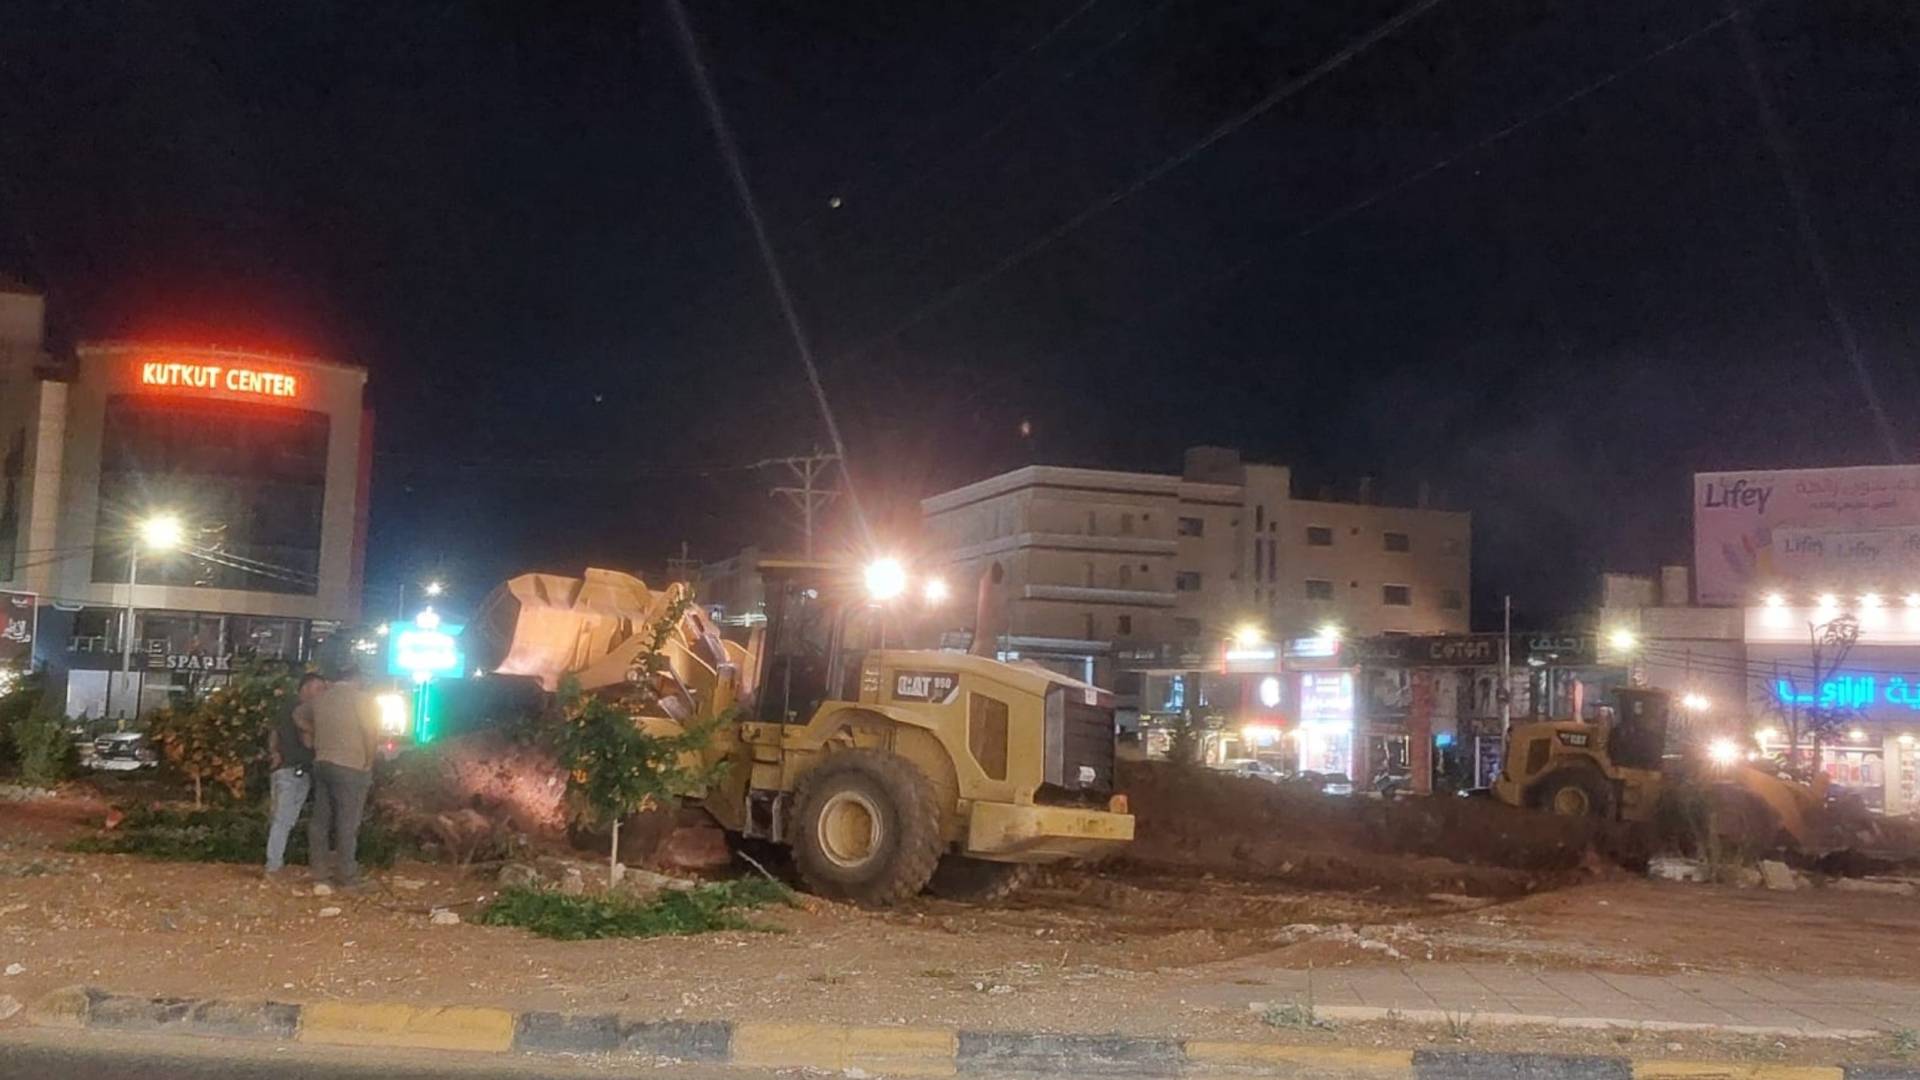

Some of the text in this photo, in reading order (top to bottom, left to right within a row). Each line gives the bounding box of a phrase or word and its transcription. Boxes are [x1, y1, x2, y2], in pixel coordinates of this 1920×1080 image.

[143, 363, 295, 396] KUTKUT CENTER
[1705, 480, 1771, 513] Lifey
[166, 653, 232, 670] SPARK
[897, 676, 932, 697] CAT
